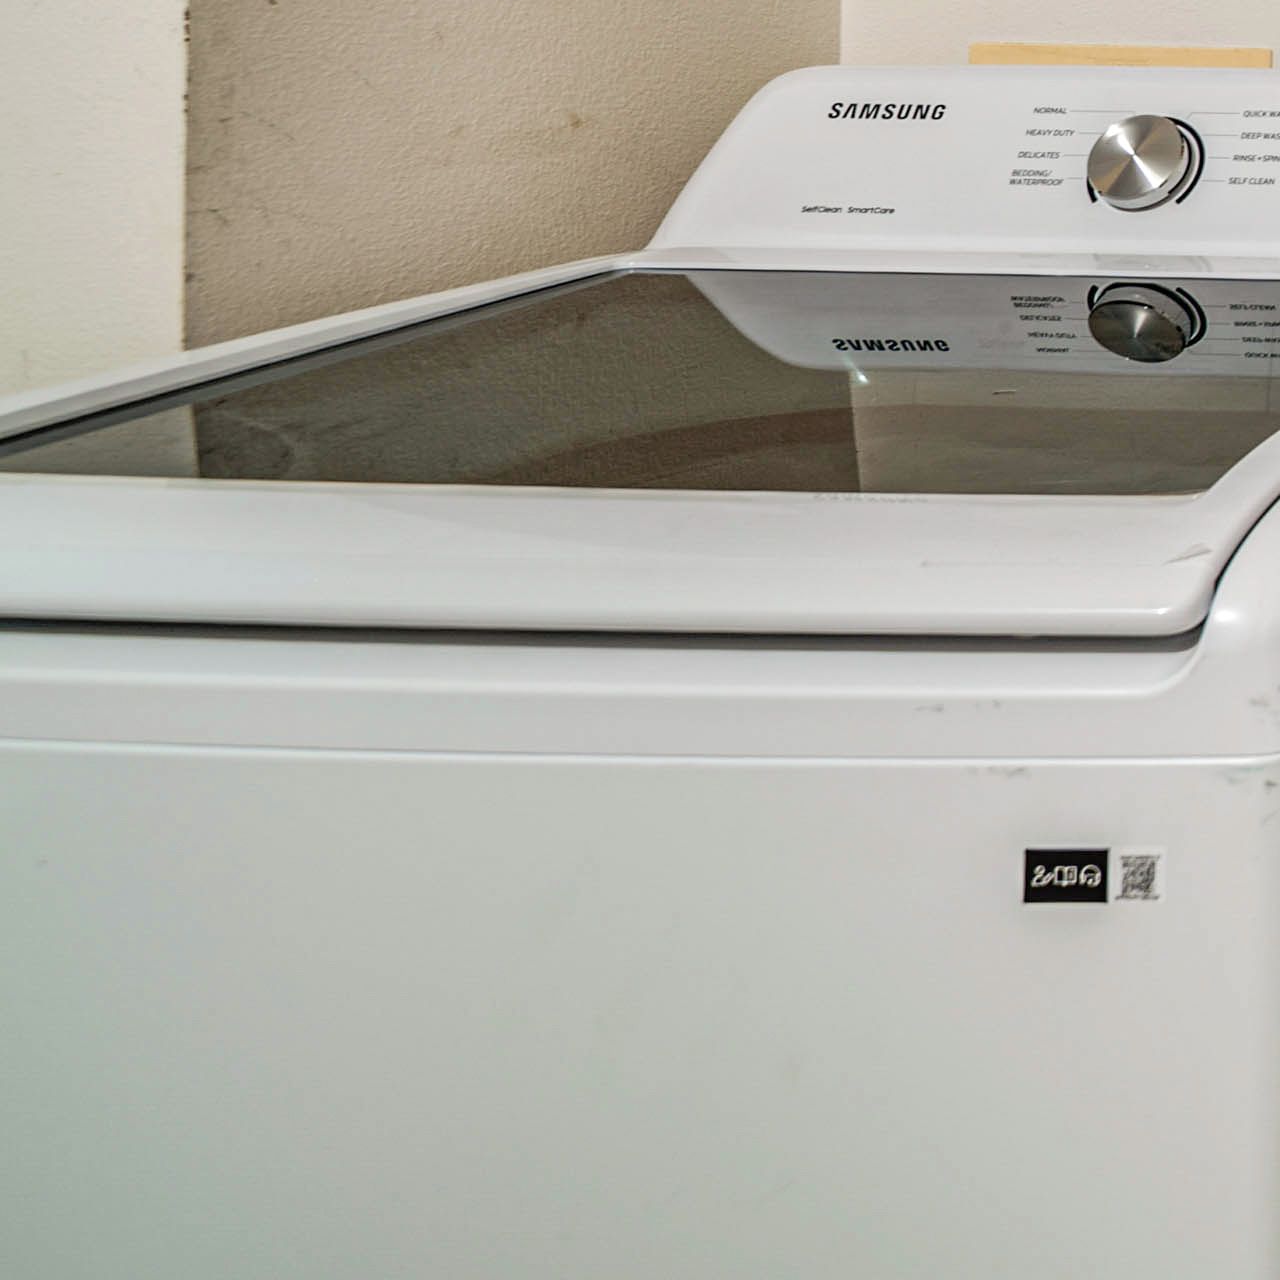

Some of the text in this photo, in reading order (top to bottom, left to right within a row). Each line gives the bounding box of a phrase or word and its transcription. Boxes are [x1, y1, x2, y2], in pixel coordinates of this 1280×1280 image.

[828, 102, 947, 121] SAMSUNG
[1243, 110, 1267, 118] QUICK
[1026, 129, 1076, 137] HEAVY DUTY
[1018, 151, 1060, 159] DELICATES
[1009, 178, 1064, 186] WATERPROOF
[1228, 177, 1276, 185] SELF CLEAN
